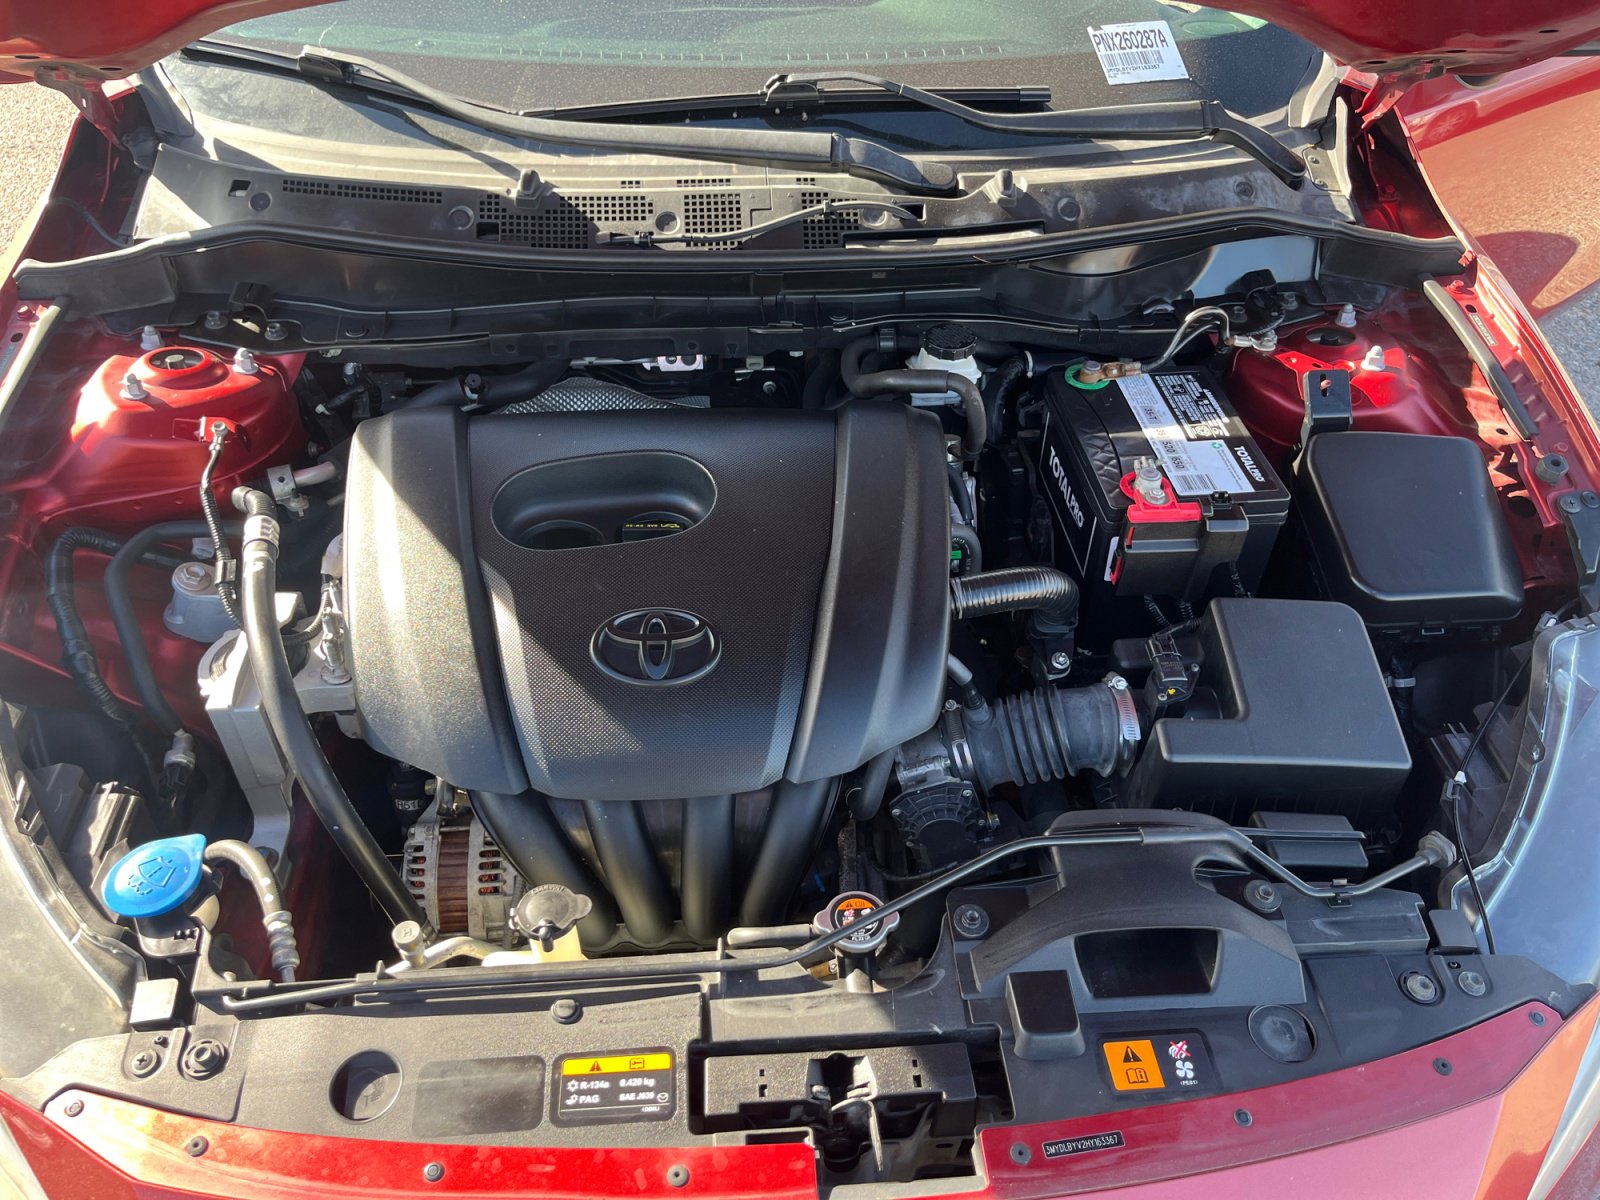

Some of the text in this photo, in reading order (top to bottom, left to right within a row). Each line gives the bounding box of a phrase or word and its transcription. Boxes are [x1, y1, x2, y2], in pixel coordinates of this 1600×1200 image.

[1092, 29, 1169, 53] PNX260287A
[1233, 445, 1265, 482] TOTALPRO
[1049, 445, 1084, 528] TOTALPRO
[403, 927, 412, 937] H
[579, 1081, 610, 1090] R-134a
[643, 1077, 656, 1087] kg
[579, 1094, 600, 1104] PAG
[619, 1092, 636, 1101] SAE
